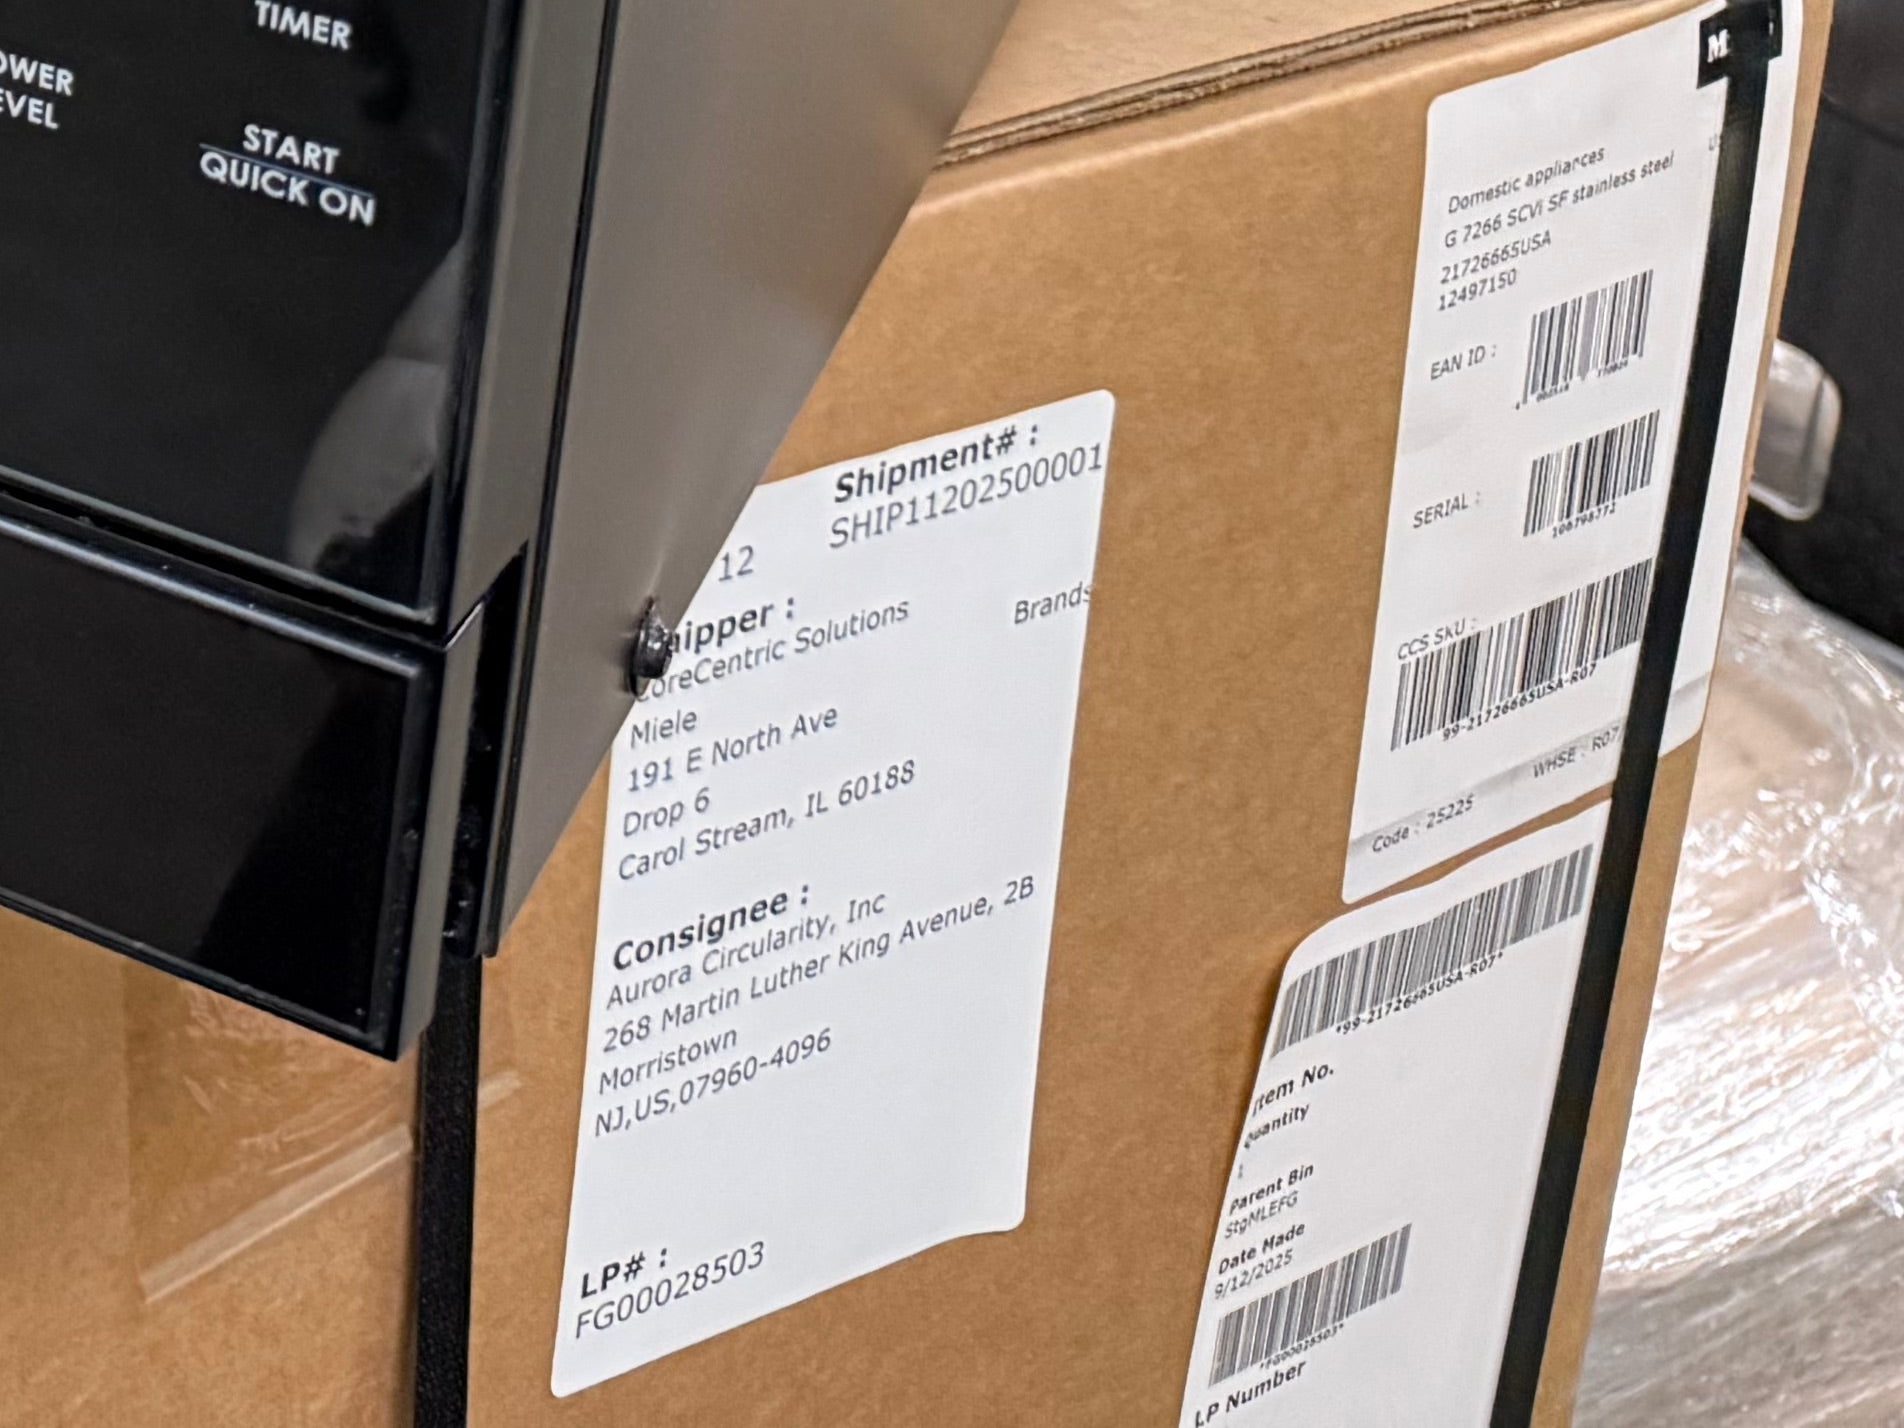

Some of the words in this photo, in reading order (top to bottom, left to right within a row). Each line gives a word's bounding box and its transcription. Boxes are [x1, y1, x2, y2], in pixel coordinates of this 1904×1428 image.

[242, 122, 340, 176] START
[199, 151, 310, 207] QUICK
[319, 186, 375, 227] ON
[1444, 230, 1457, 250] G
[1463, 215, 1502, 245] 7266
[1507, 201, 1544, 229] SCVi
[1547, 189, 1569, 214] SF
[1572, 169, 1636, 204] stainless
[1640, 150, 1675, 178] steel
[1447, 178, 1521, 216] Domestic
[1525, 147, 1606, 189] appliances
[1437, 267, 1517, 312] 12497150
[1430, 353, 1463, 381] EAN
[1467, 345, 1486, 367] ID
[834, 424, 1018, 504] Shipment#
[1029, 425, 1039, 446] :
[829, 442, 1103, 549] SHIP11202500001
[1412, 493, 1469, 529] SERIAL
[718, 545, 755, 583] 12
[668, 603, 774, 654] ipper
[794, 600, 910, 655] Solutions
[1397, 633, 1429, 661] CCS
[1434, 617, 1467, 646] SKU
[628, 756, 674, 792] 191
[686, 746, 703, 774] E
[711, 723, 782, 766] North
[791, 707, 838, 740] Ave
[630, 710, 698, 749] Miele
[1533, 747, 1577, 779] WHSE
[618, 836, 685, 881] Carol
[694, 807, 794, 856] Stream,
[805, 791, 829, 818] IL
[838, 759, 915, 807] 60188
[622, 801, 684, 837] Drop
[694, 787, 711, 814] 6
[1372, 825, 1410, 854] Code
[606, 962, 692, 1011] Aurora
[702, 913, 837, 976] Circularity,
[847, 892, 886, 925] Inc
[612, 889, 789, 972] Consignee
[800, 883, 810, 906] :
[602, 1015, 652, 1054] 268
[660, 987, 740, 1032] Martin
[750, 952, 831, 1000] Luther
[838, 931, 891, 968] King
[899, 894, 994, 945] Avenue,
[1003, 875, 1035, 907] 2B
[594, 1027, 832, 1139] NJ,US,07960-4096
[599, 1027, 738, 1095] Morristown
[1301, 1063, 1335, 1089] No.
[1229, 1177, 1283, 1217] Parent
[1288, 1164, 1314, 1187] Bin
[581, 1250, 646, 1299] LP#
[659, 1247, 667, 1268] :
[1214, 1248, 1294, 1301] 9/12/2025
[1218, 1248, 1257, 1275] Date
[1262, 1223, 1306, 1254] Made
[575, 1240, 765, 1340] FG00028503
[1195, 1402, 1219, 1428] LP
[1226, 1361, 1306, 1413] Number
